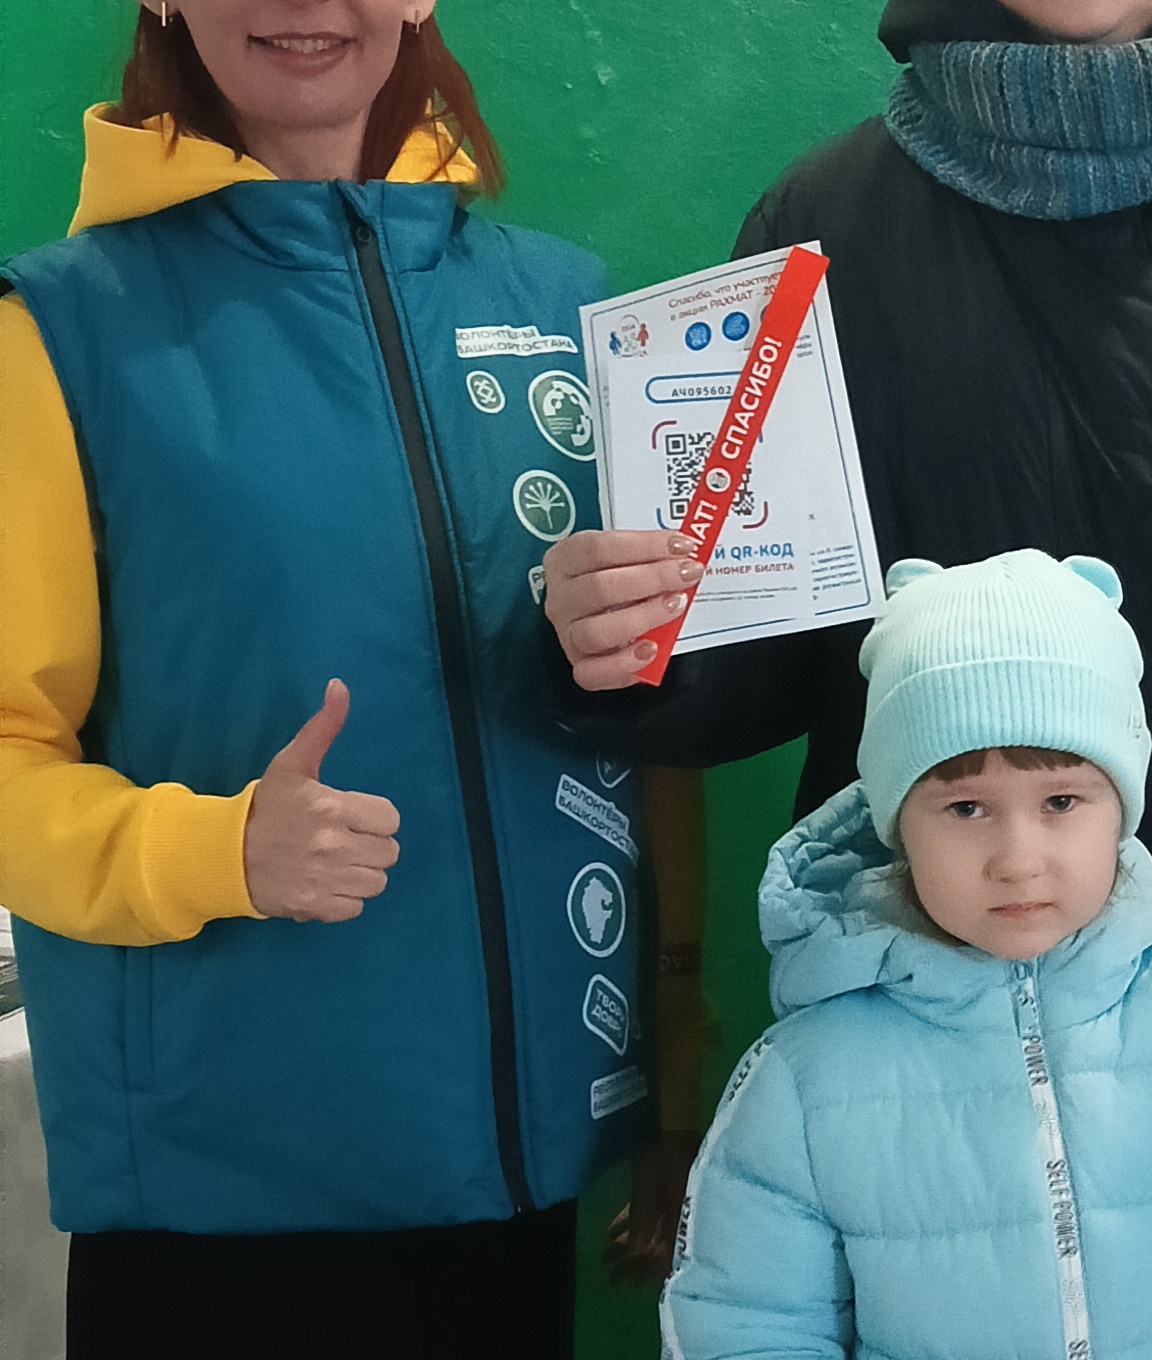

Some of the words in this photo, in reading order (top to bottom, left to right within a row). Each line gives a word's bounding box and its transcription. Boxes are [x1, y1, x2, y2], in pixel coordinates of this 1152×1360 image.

[721, 336, 782, 460] СПАСИБО!
[715, 566, 752, 576] НОМЕР
[754, 562, 794, 574] БИЛЕТА
[730, 543, 794, 562] QR-КОД
[1046, 1159, 1068, 1197] SELF
[1052, 1198, 1079, 1260] POWER
